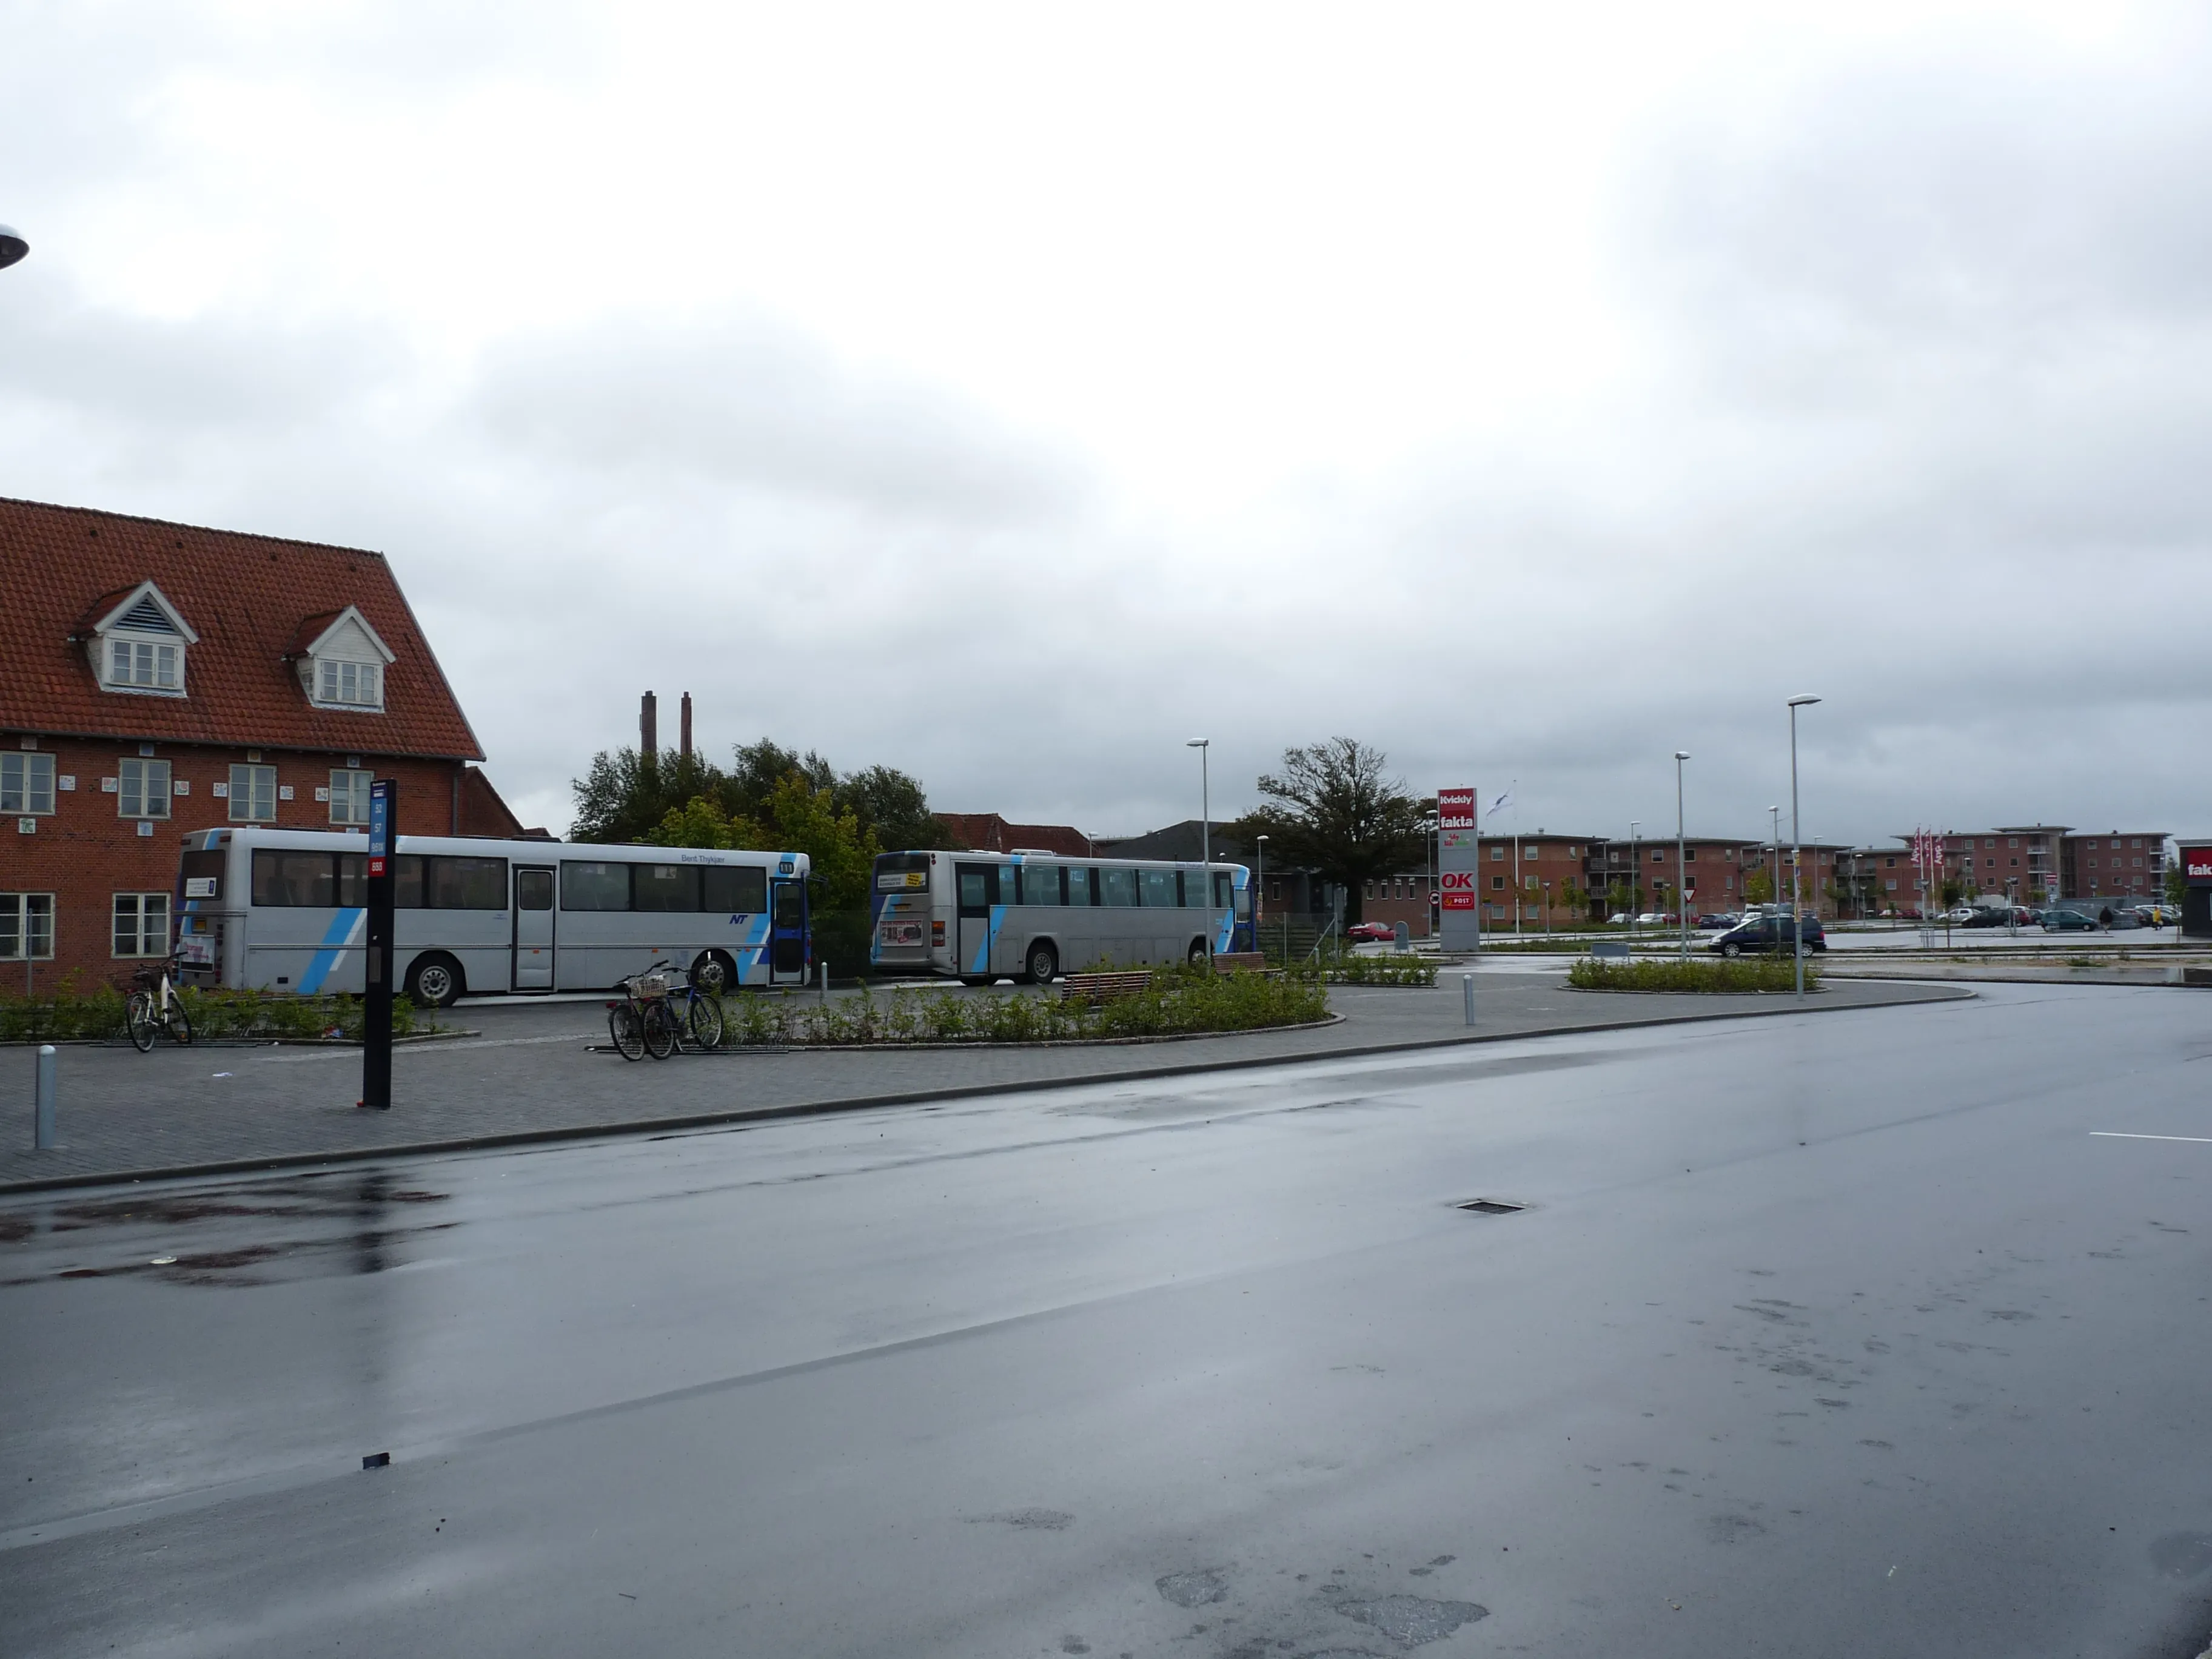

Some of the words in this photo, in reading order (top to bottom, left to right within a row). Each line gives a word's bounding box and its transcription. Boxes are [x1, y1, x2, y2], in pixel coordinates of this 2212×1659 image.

[1439, 795, 1472, 805] Kvickly
[1441, 816, 1473, 828] fakta
[780, 863, 793, 872] 111
[1441, 873, 1473, 889] OK
[729, 914, 748, 925] NT
